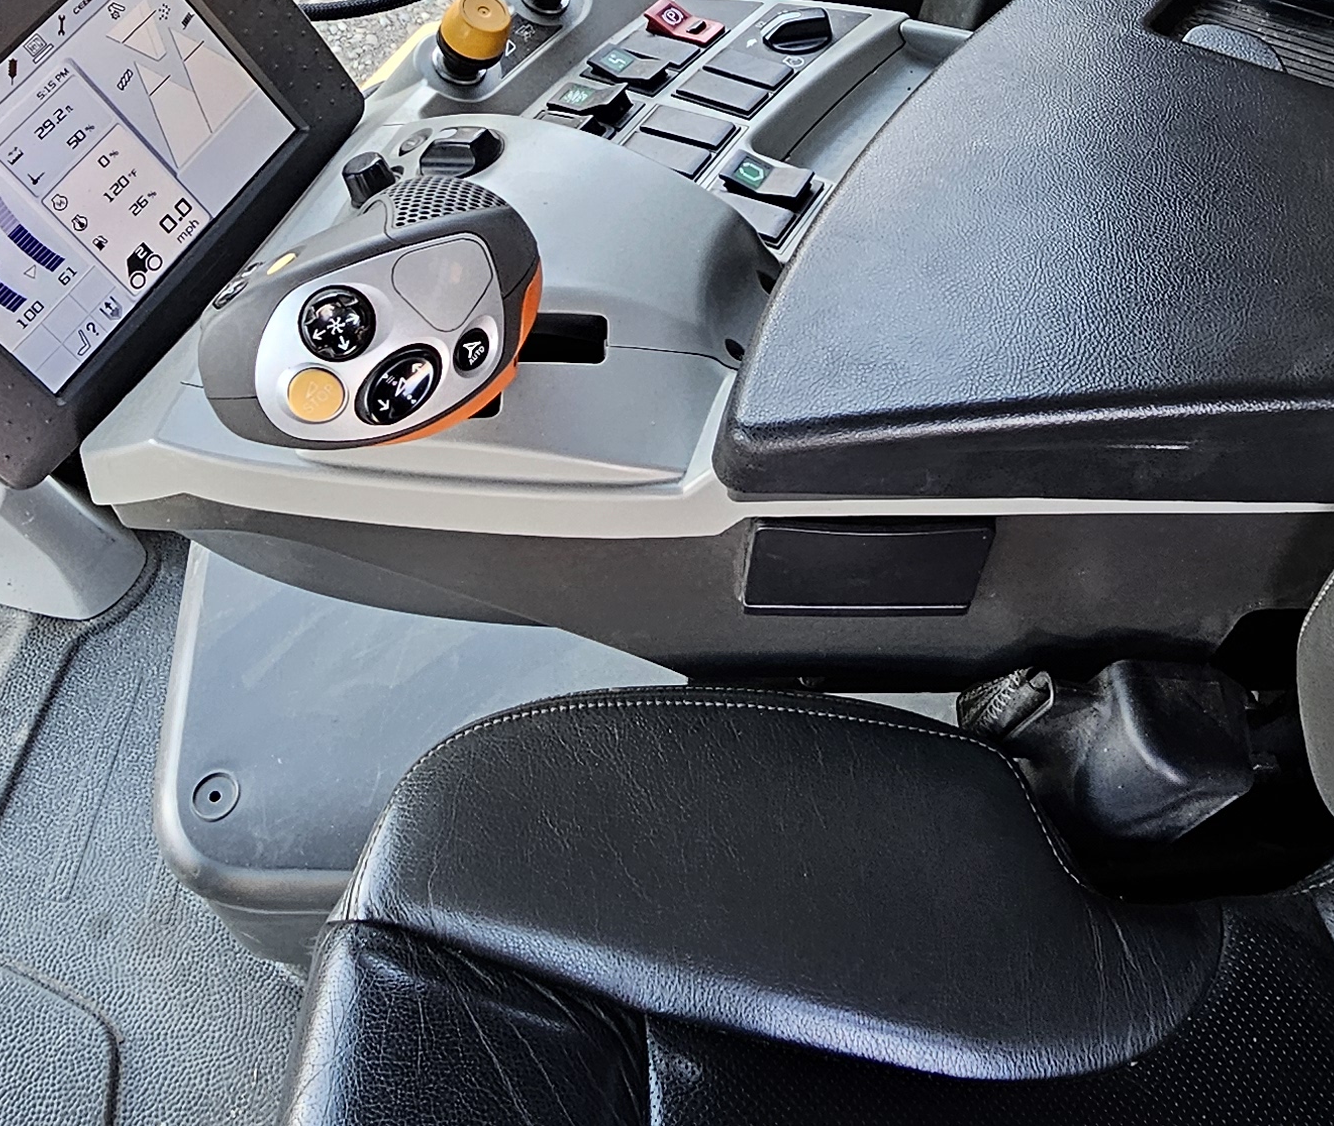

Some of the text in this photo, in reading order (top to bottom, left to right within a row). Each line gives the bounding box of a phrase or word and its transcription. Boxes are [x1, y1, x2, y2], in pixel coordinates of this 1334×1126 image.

[36, 68, 71, 101] 5:15 PM
[33, 107, 68, 140] 29.2
[66, 129, 87, 150] 50
[97, 154, 110, 168] 0
[103, 175, 130, 203] 120
[128, 195, 149, 217] 26
[159, 197, 193, 234] 0.0
[176, 219, 200, 244] mph
[57, 267, 78, 286] 61
[16, 300, 45, 329] 100
[468, 345, 485, 366] AUTO
[302, 383, 334, 414] STOP
